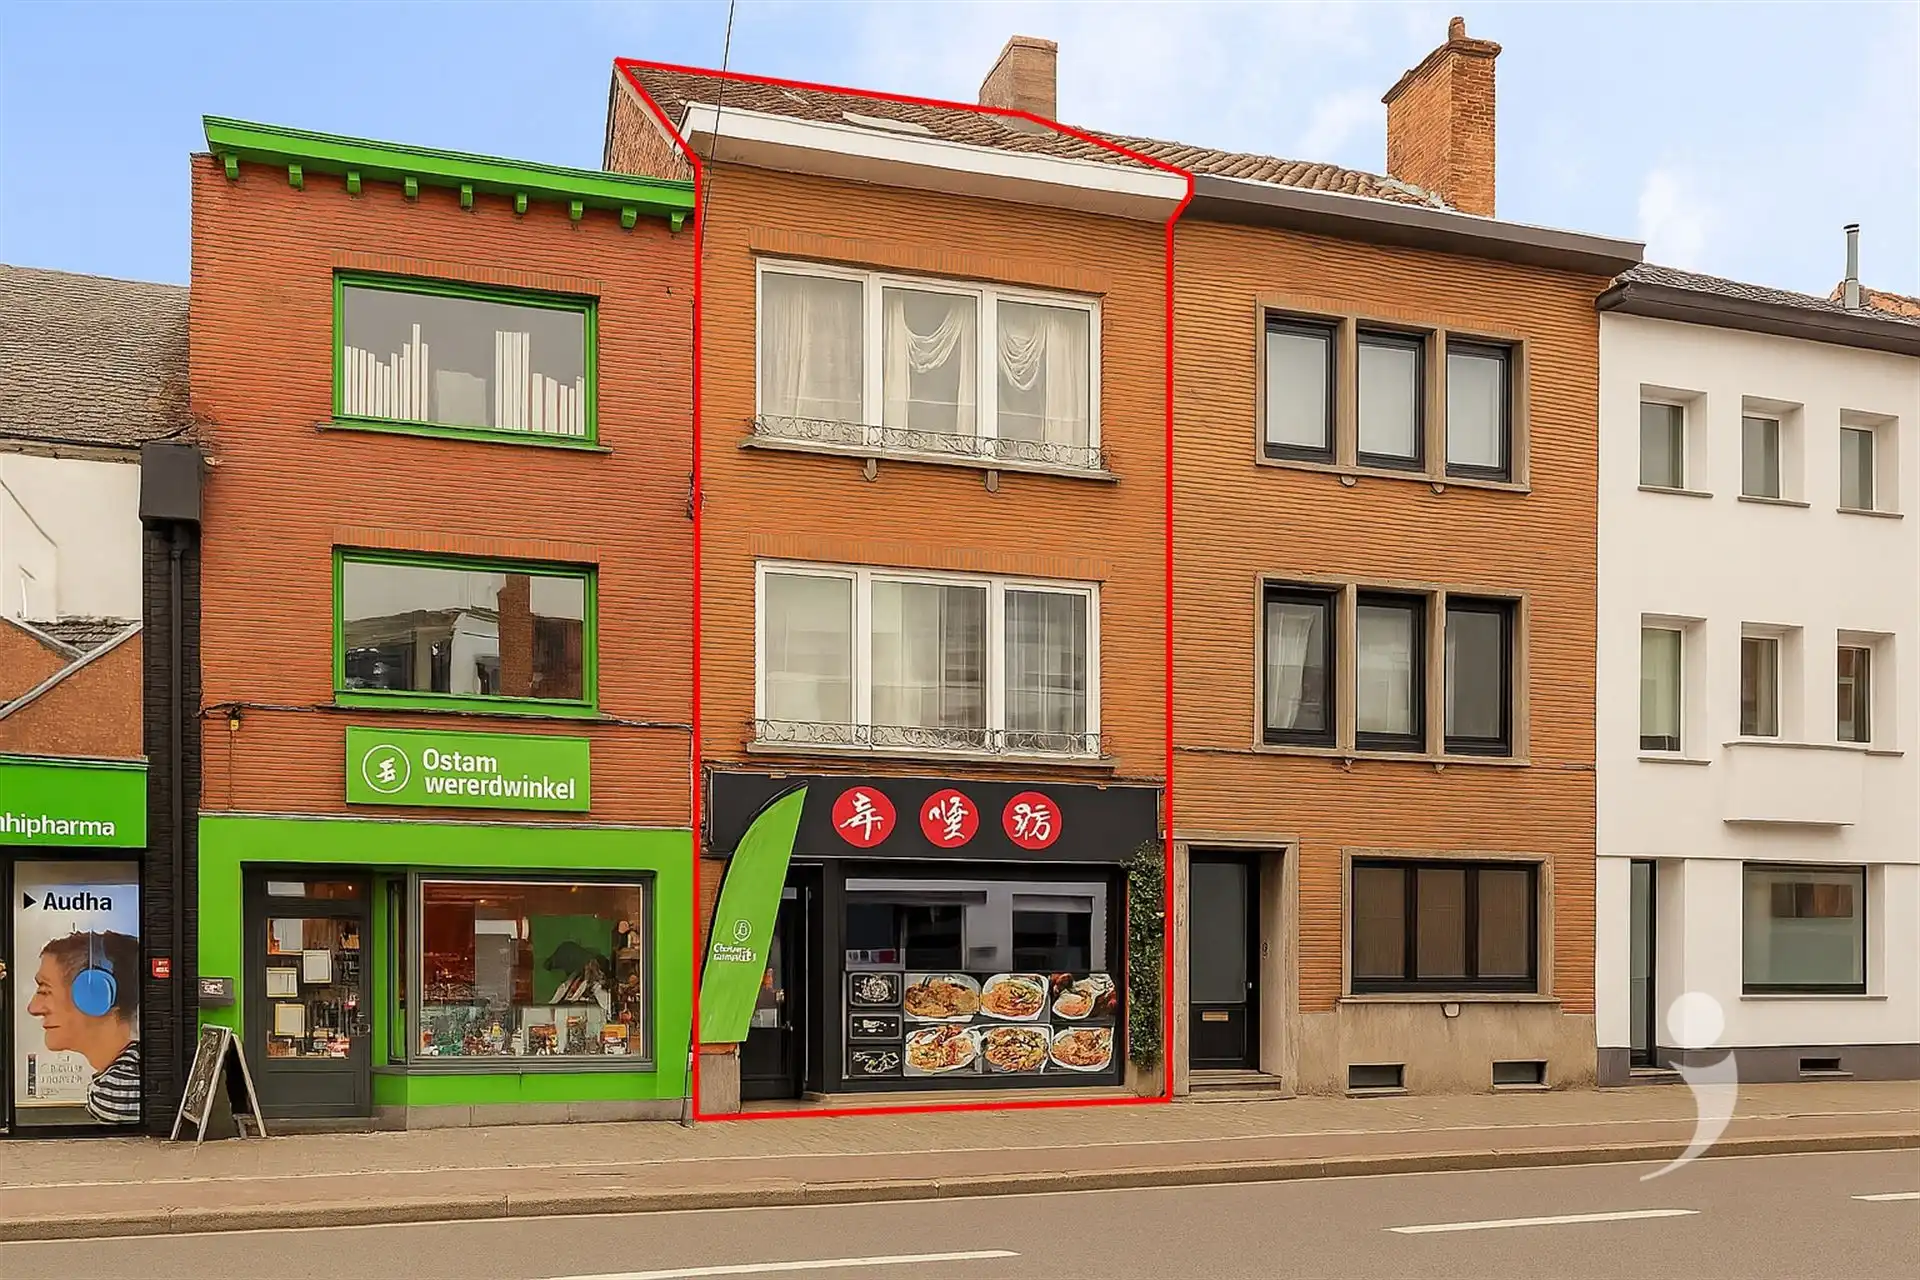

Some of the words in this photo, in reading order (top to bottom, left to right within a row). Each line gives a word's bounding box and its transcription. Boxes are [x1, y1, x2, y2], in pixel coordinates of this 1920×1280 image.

[422, 748, 497, 773] Ostam
[425, 775, 575, 800] wererdwinkel
[43, 892, 112, 911] Audha
